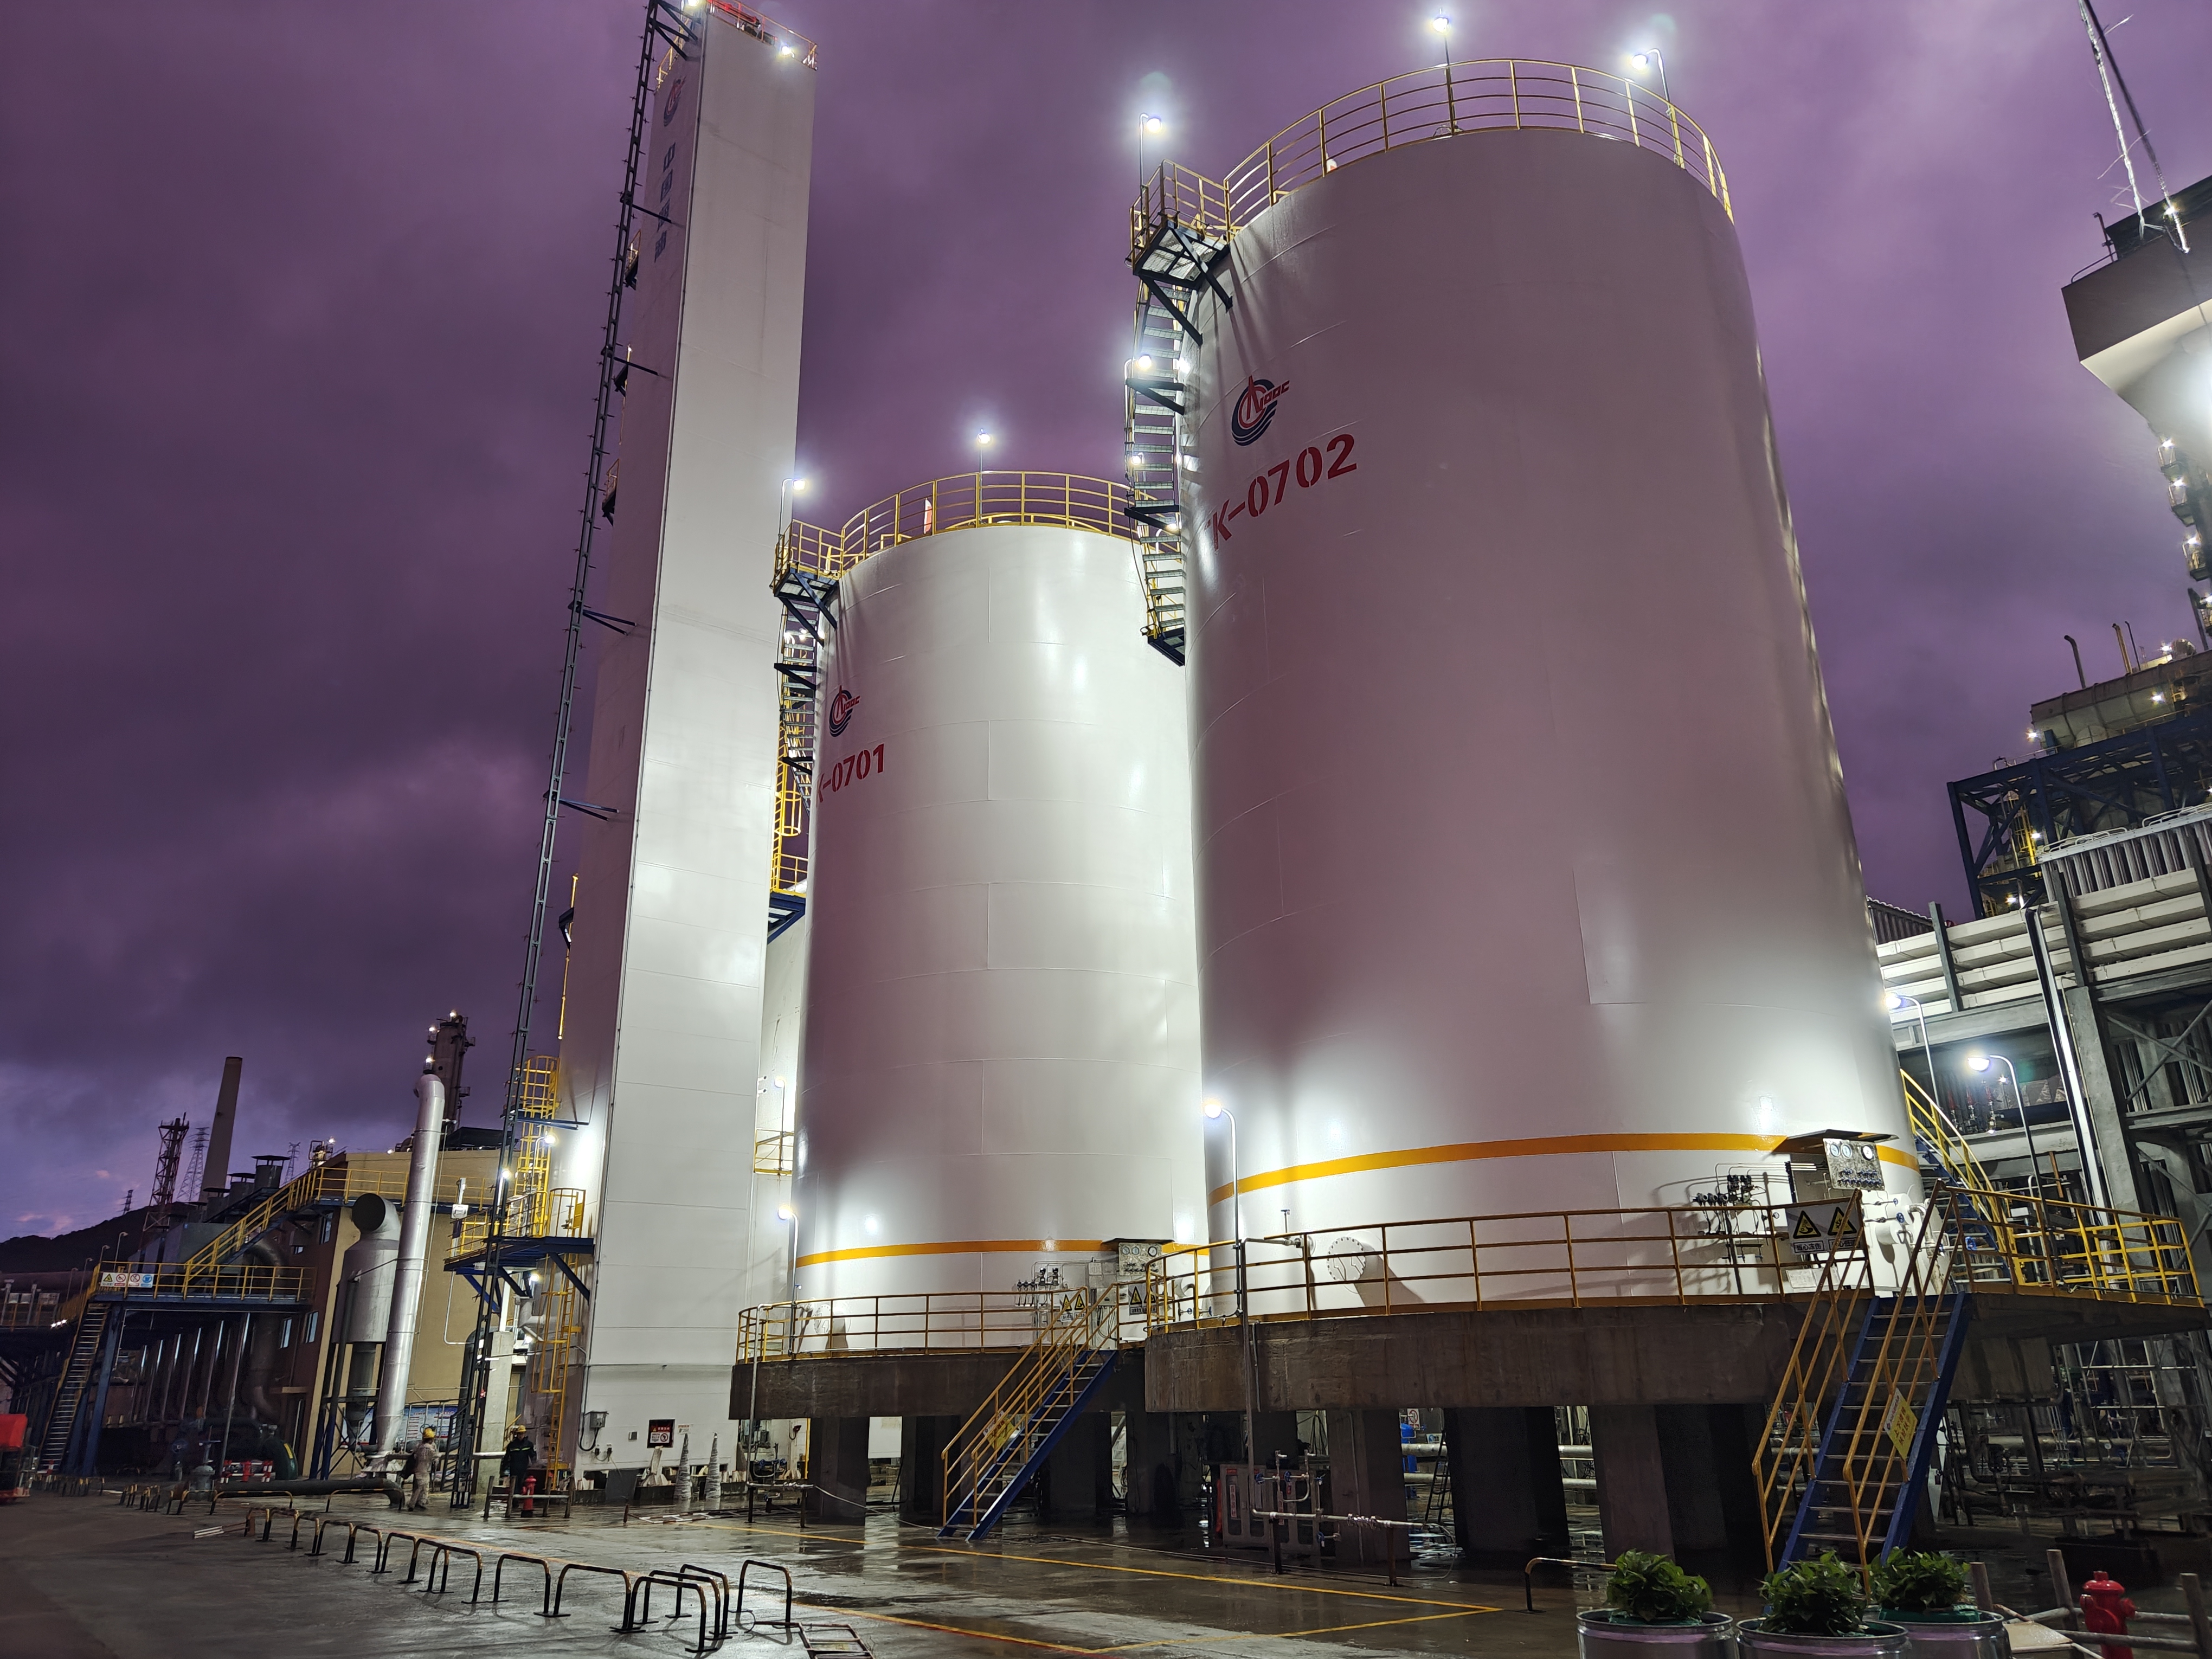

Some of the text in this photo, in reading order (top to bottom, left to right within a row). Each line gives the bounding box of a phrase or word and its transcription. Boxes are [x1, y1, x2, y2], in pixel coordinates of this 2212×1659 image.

[1204, 434, 1357, 551] K-0702
[1796, 1243, 1821, 1251] 当心冻伤
